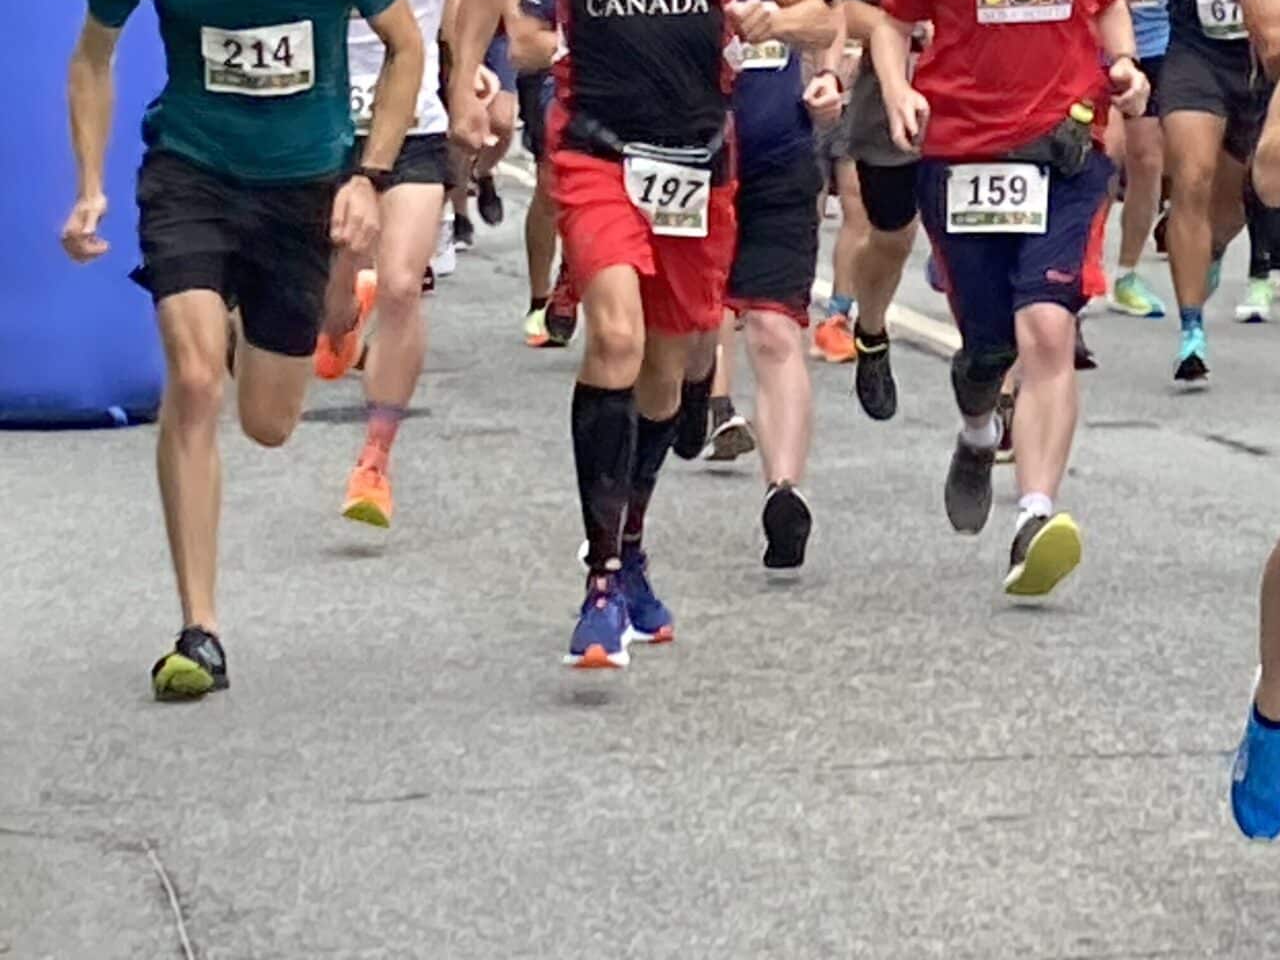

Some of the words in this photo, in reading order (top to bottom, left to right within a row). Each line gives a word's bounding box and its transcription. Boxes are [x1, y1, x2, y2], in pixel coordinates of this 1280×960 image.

[223, 36, 294, 68] 214
[639, 173, 705, 208] 197
[968, 175, 1028, 206] 159
